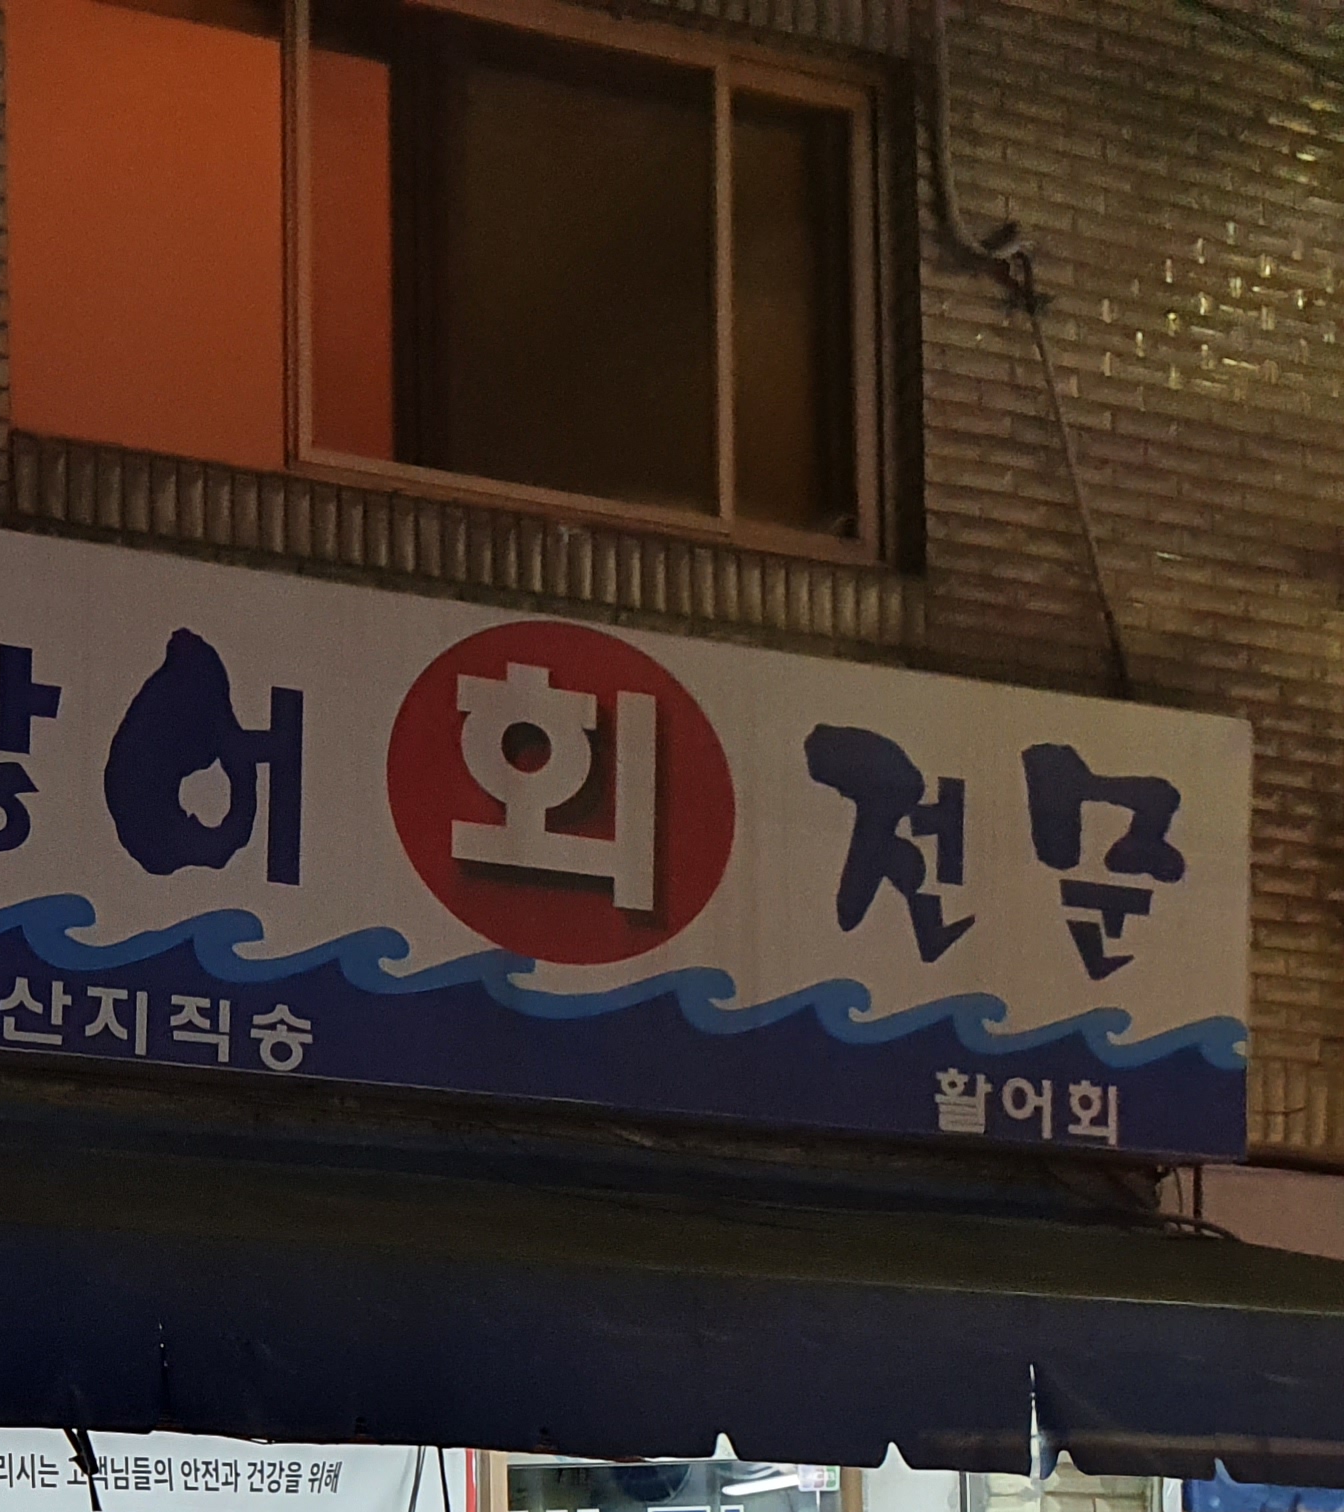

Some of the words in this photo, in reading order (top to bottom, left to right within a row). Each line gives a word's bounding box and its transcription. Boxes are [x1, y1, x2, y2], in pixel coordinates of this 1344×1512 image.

[451, 662, 658, 911] 회
[803, 723, 1186, 981] 전문
[0, 976, 313, 1071] 산지직송
[934, 1067, 1118, 1146] 활어회
[180, 1458, 241, 1493] 안전과
[246, 1460, 304, 1494] 건강을
[308, 1461, 343, 1495] 위해
